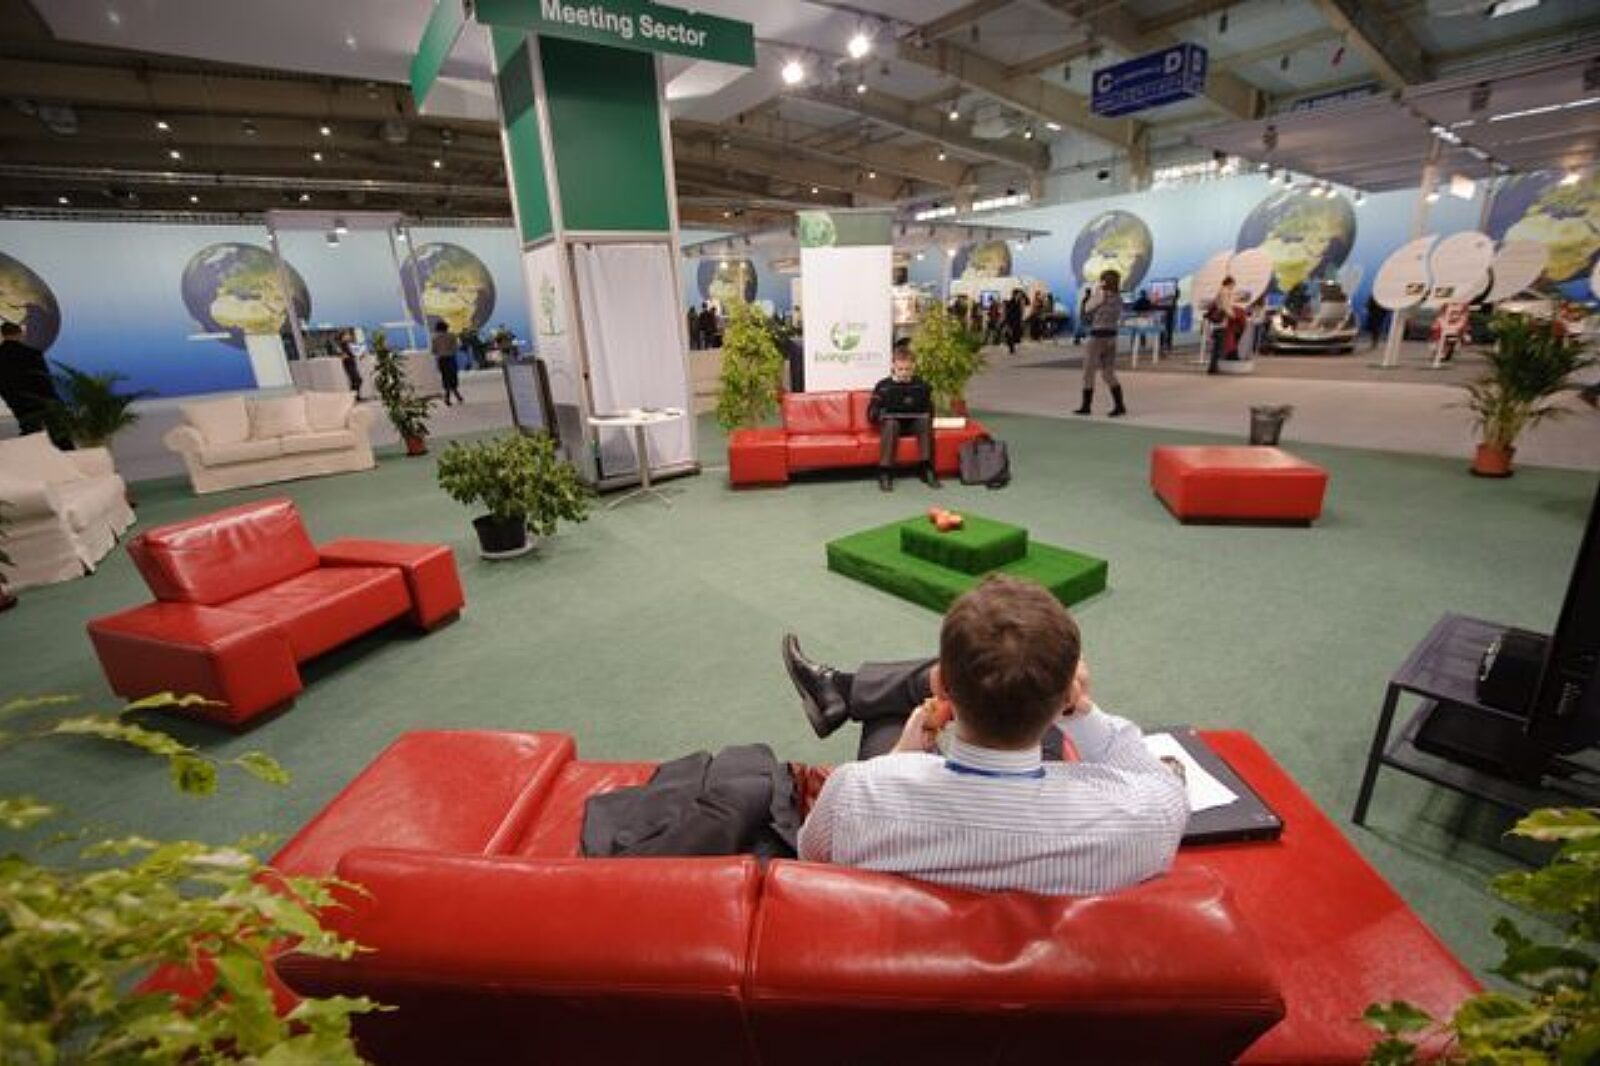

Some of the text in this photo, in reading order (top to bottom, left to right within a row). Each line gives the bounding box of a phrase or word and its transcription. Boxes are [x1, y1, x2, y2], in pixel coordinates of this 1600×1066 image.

[541, 0, 708, 47] Meeting Sector
[1097, 72, 1112, 94] C
[1164, 51, 1181, 74] D
